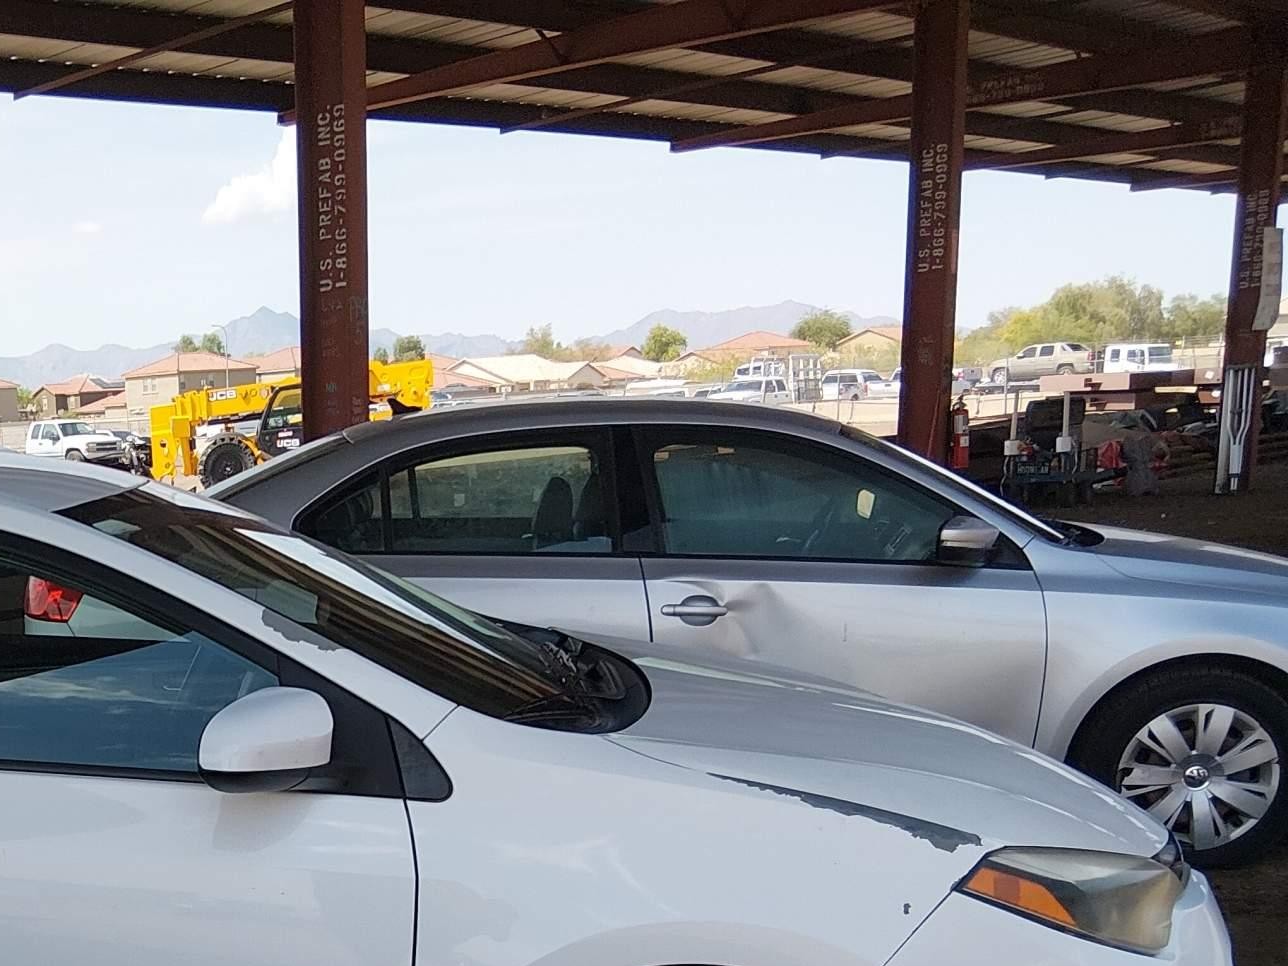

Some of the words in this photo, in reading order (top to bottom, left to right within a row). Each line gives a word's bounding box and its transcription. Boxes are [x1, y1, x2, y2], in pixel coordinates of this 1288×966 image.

[317, 104, 331, 146] INC.
[922, 144, 934, 172] INC.
[318, 157, 332, 240] PREFAB
[333, 103, 348, 288] 1-866-799-0969
[919, 180, 933, 237] PREFAB
[931, 143, 948, 269] 1-866-799-0969
[319, 251, 333, 292] U.S.
[918, 244, 931, 272] U.S.
